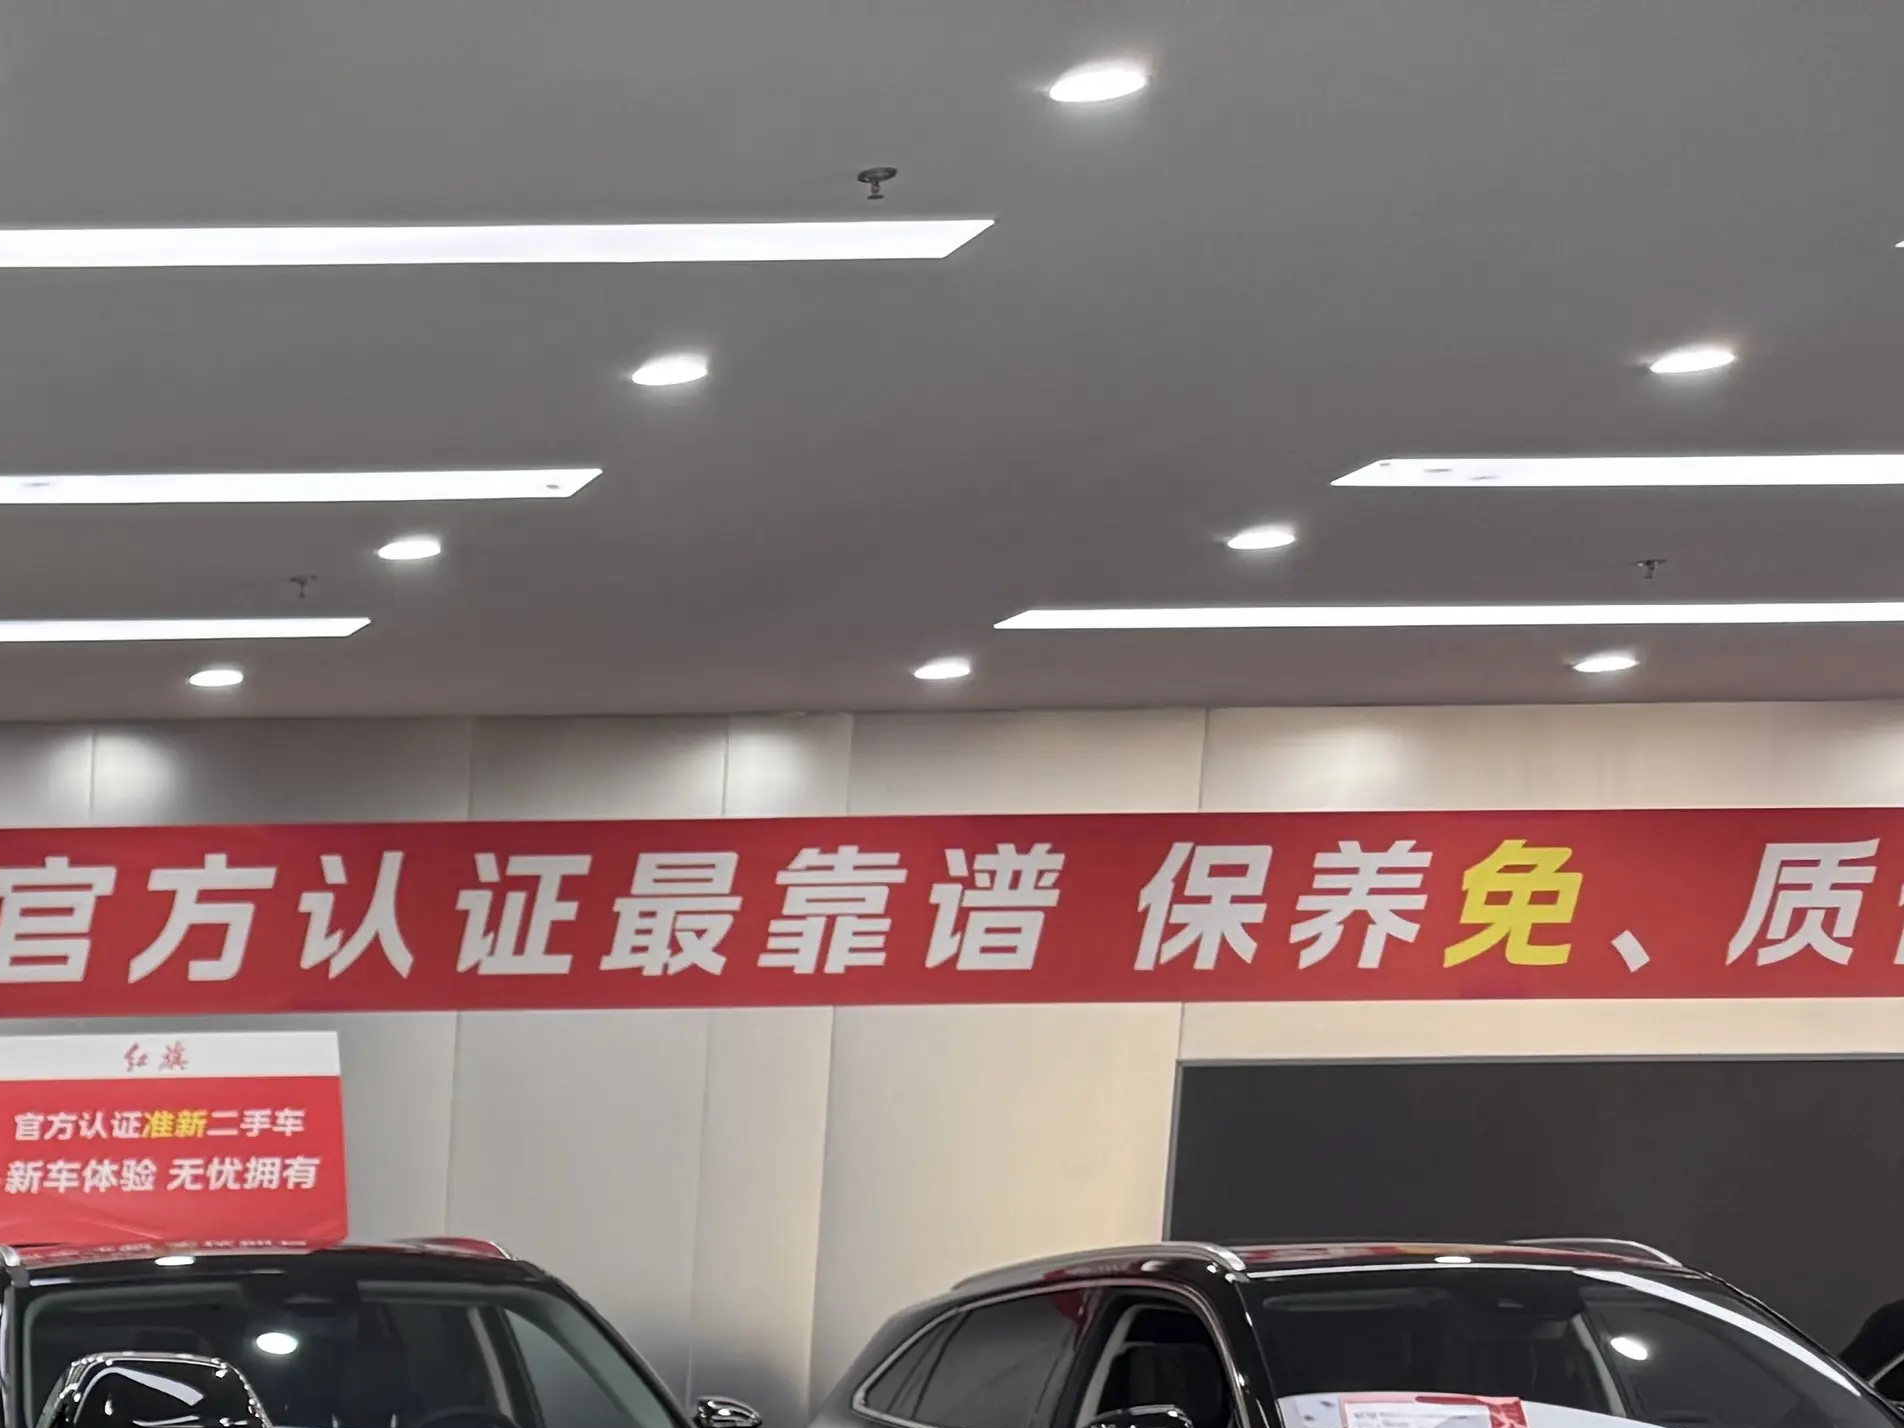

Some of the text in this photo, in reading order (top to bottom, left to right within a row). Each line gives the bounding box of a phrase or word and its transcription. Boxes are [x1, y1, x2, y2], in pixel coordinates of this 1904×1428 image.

[1134, 837, 1904, 974] 保养免、质
[123, 1041, 190, 1072] 红旗
[13, 1107, 306, 1142] 官方认证准新二手车
[3, 1154, 321, 1195] 新车体验 无忧拥有
